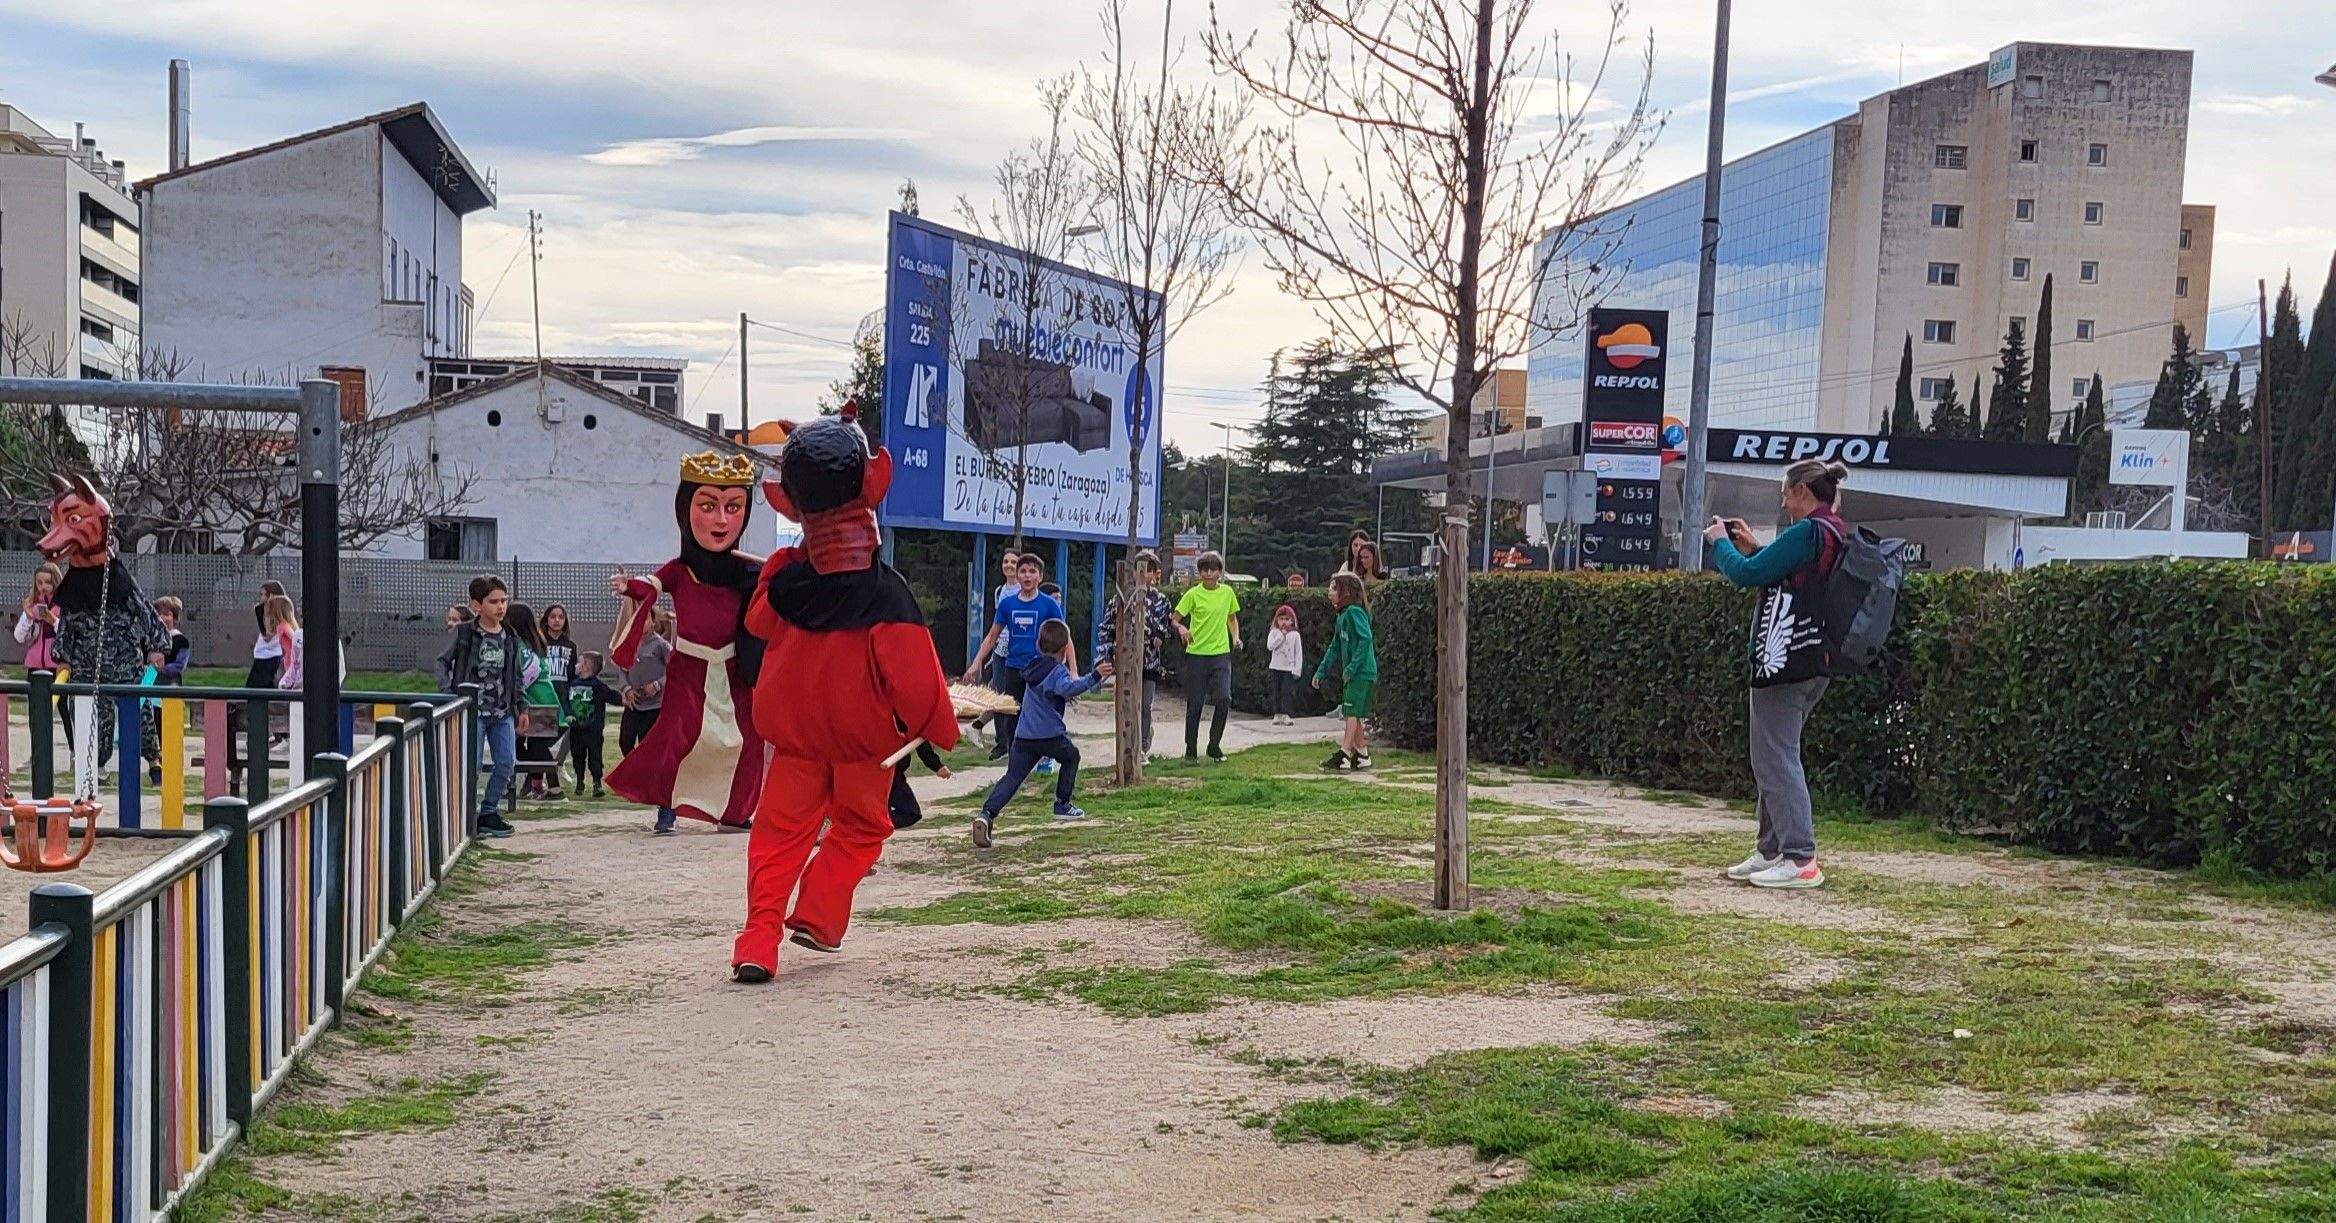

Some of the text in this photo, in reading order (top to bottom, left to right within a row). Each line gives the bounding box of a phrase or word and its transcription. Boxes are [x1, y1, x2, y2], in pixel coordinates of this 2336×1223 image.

[899, 255, 916, 272] Crta.
[910, 323, 930, 347] 225
[1594, 375, 1659, 390] REPSOL
[903, 447, 928, 469] A-68
[1733, 435, 1891, 464] REPSOL
[2120, 453, 2154, 468] Klin
[955, 455, 968, 476] EL
[1028, 465, 1055, 488] EBRO
[1057, 462, 1110, 499] (Zaragoza)
[1115, 467, 1153, 487] DE HSCA
[1622, 487, 1654, 500] 1.559
[954, 480, 971, 511] De
[976, 480, 989, 517] la
[993, 487, 1037, 524] fabca
[1041, 502, 1048, 519] a
[1051, 492, 1065, 525] tu
[1067, 506, 1091, 529] casa
[1094, 497, 1123, 531] desde
[1620, 512, 1653, 525] 1.649
[1620, 538, 1651, 551] 1.649
